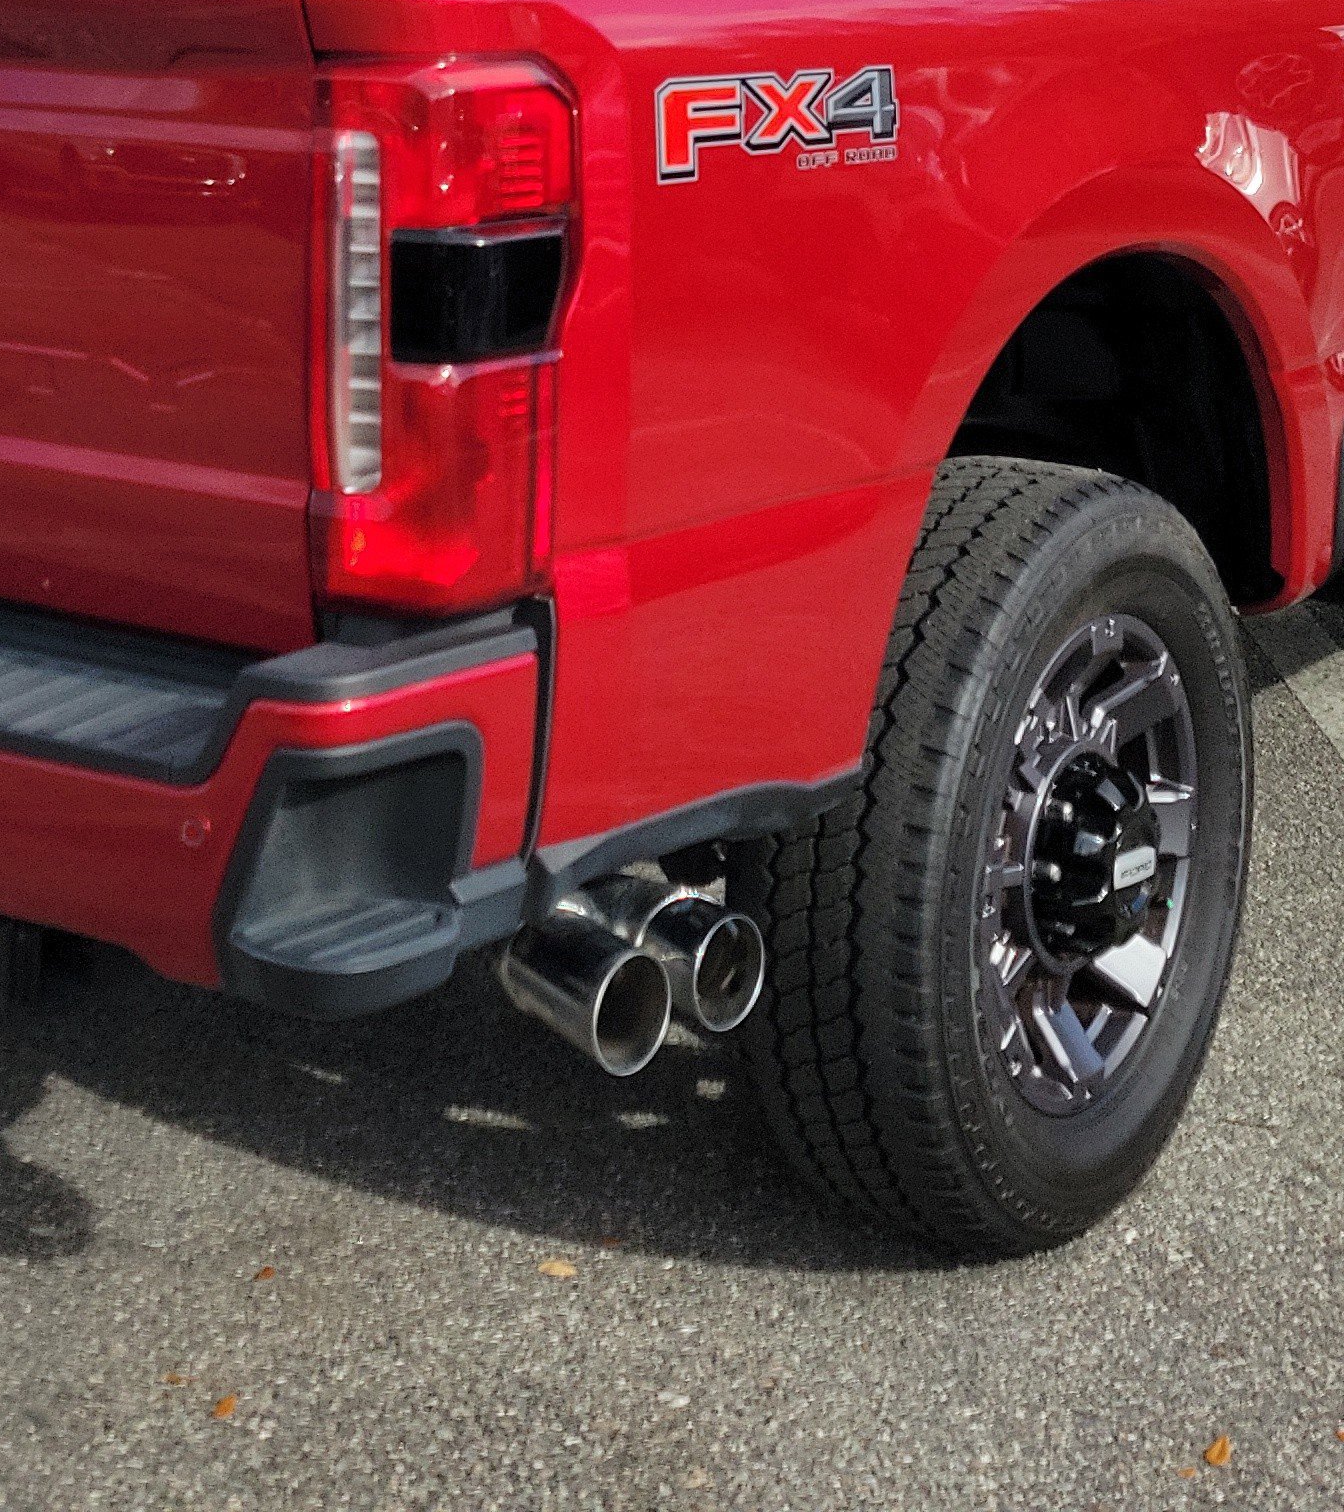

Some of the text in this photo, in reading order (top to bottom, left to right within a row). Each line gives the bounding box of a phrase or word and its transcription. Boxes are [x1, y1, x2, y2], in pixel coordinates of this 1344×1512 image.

[655, 65, 899, 185] FX4
[797, 145, 897, 170] OFF ROAD
